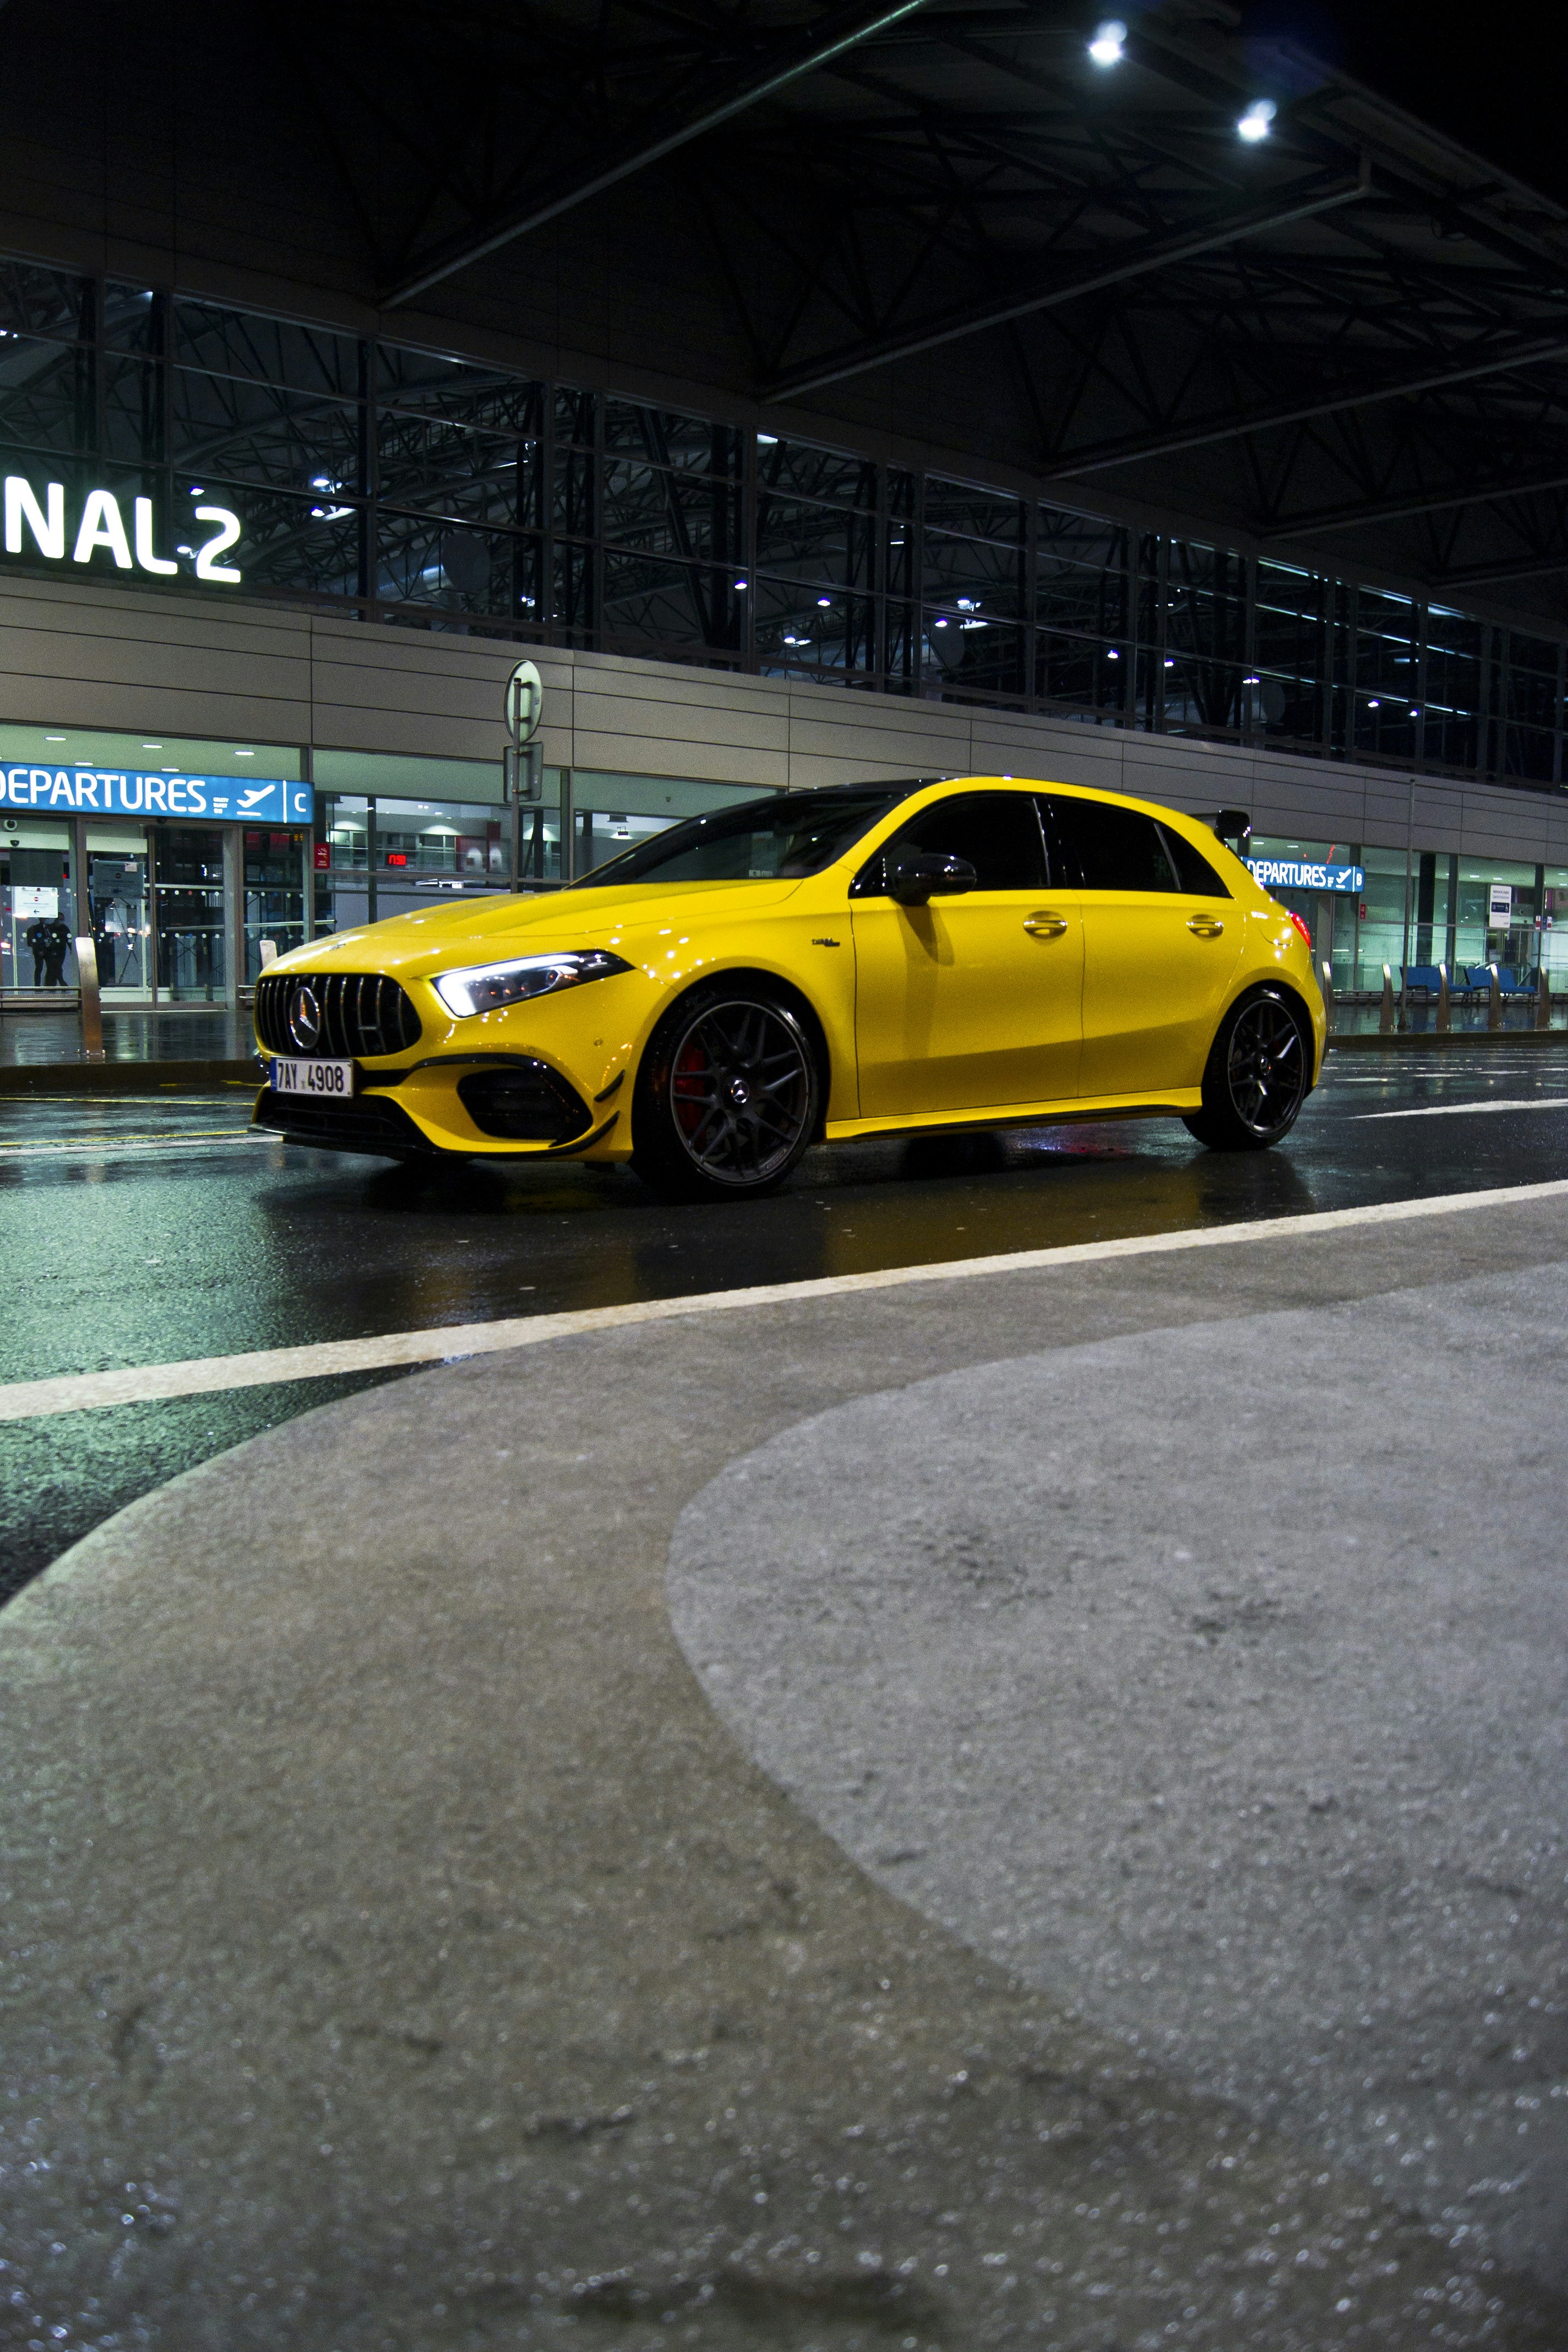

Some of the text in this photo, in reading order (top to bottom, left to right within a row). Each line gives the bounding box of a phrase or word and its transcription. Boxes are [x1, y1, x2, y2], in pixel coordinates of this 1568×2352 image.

[5, 476, 241, 583] NAL 2
[294, 793, 307, 813] C
[1247, 860, 1326, 887] DEPARTURES
[1356, 873, 1362, 886] B
[278, 1062, 344, 1092] 7AY 4908
